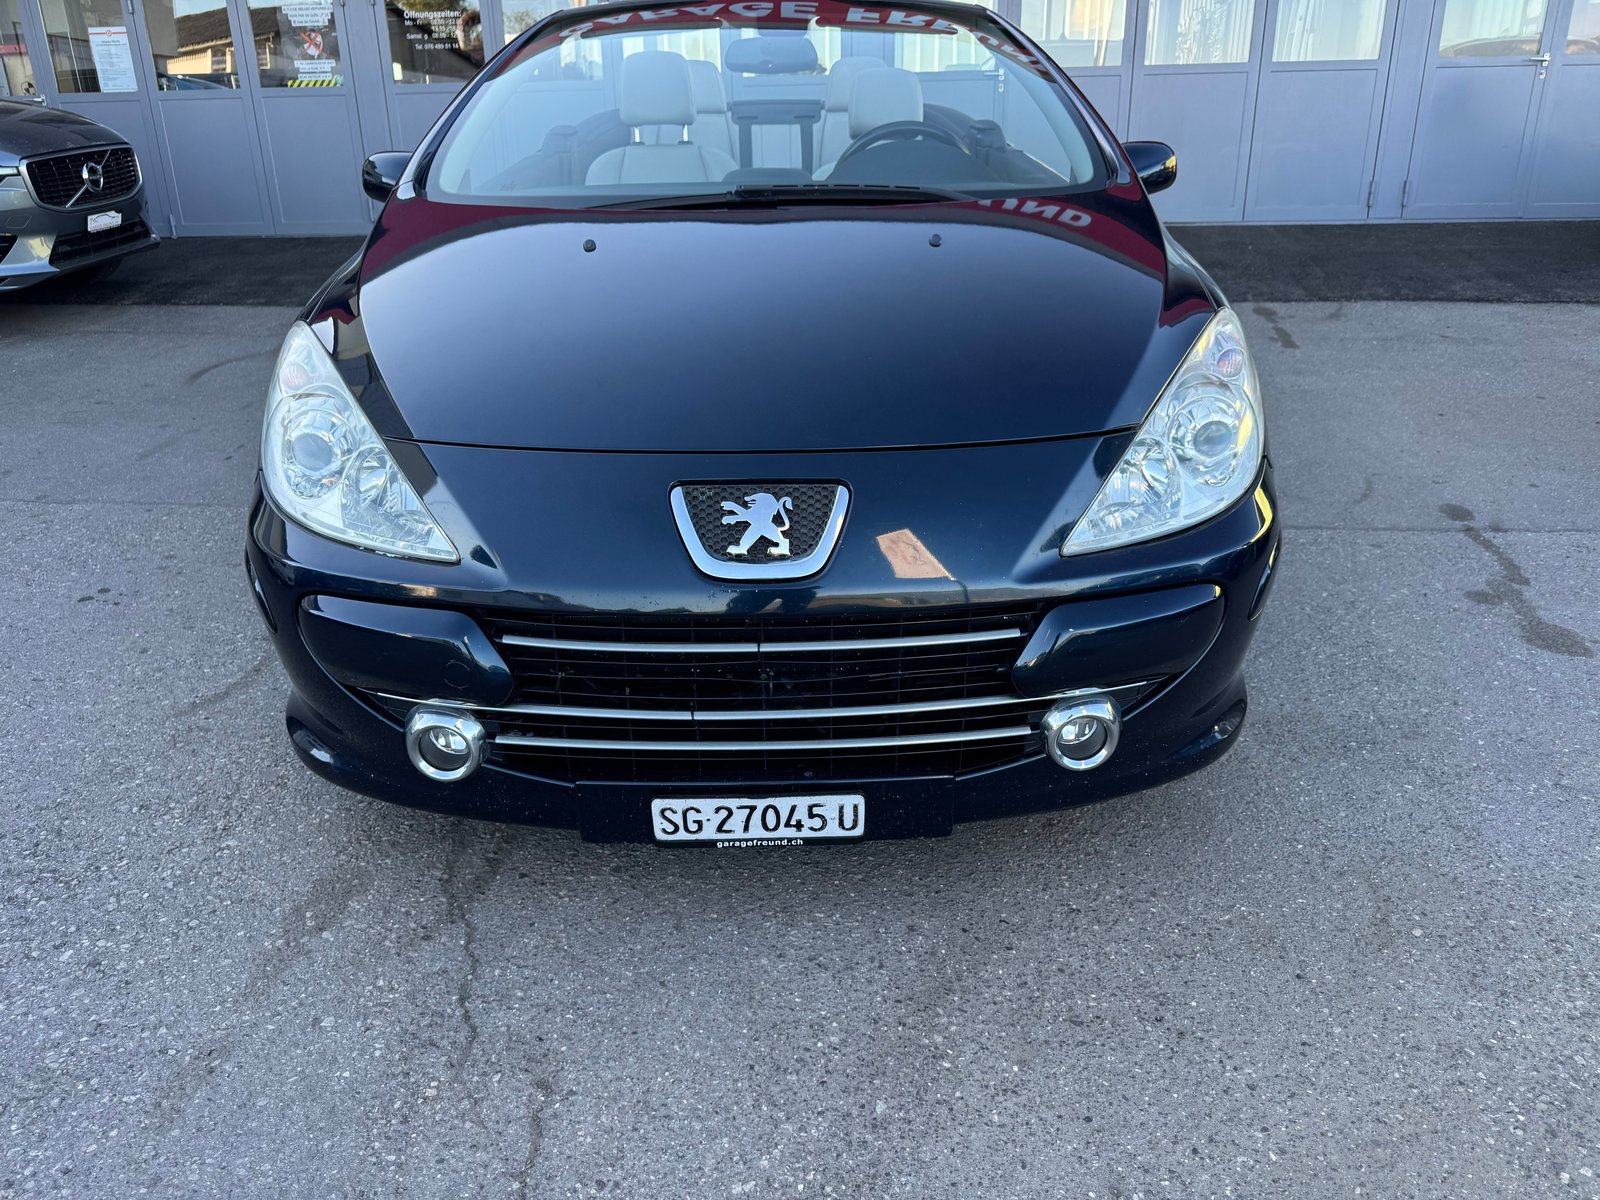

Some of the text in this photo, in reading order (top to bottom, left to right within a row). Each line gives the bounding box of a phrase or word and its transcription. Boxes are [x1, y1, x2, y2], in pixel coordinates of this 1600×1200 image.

[404, 9, 461, 19] Öffnungszeiten:
[838, 802, 860, 832] U
[717, 838, 803, 848] garagefreund.ch
